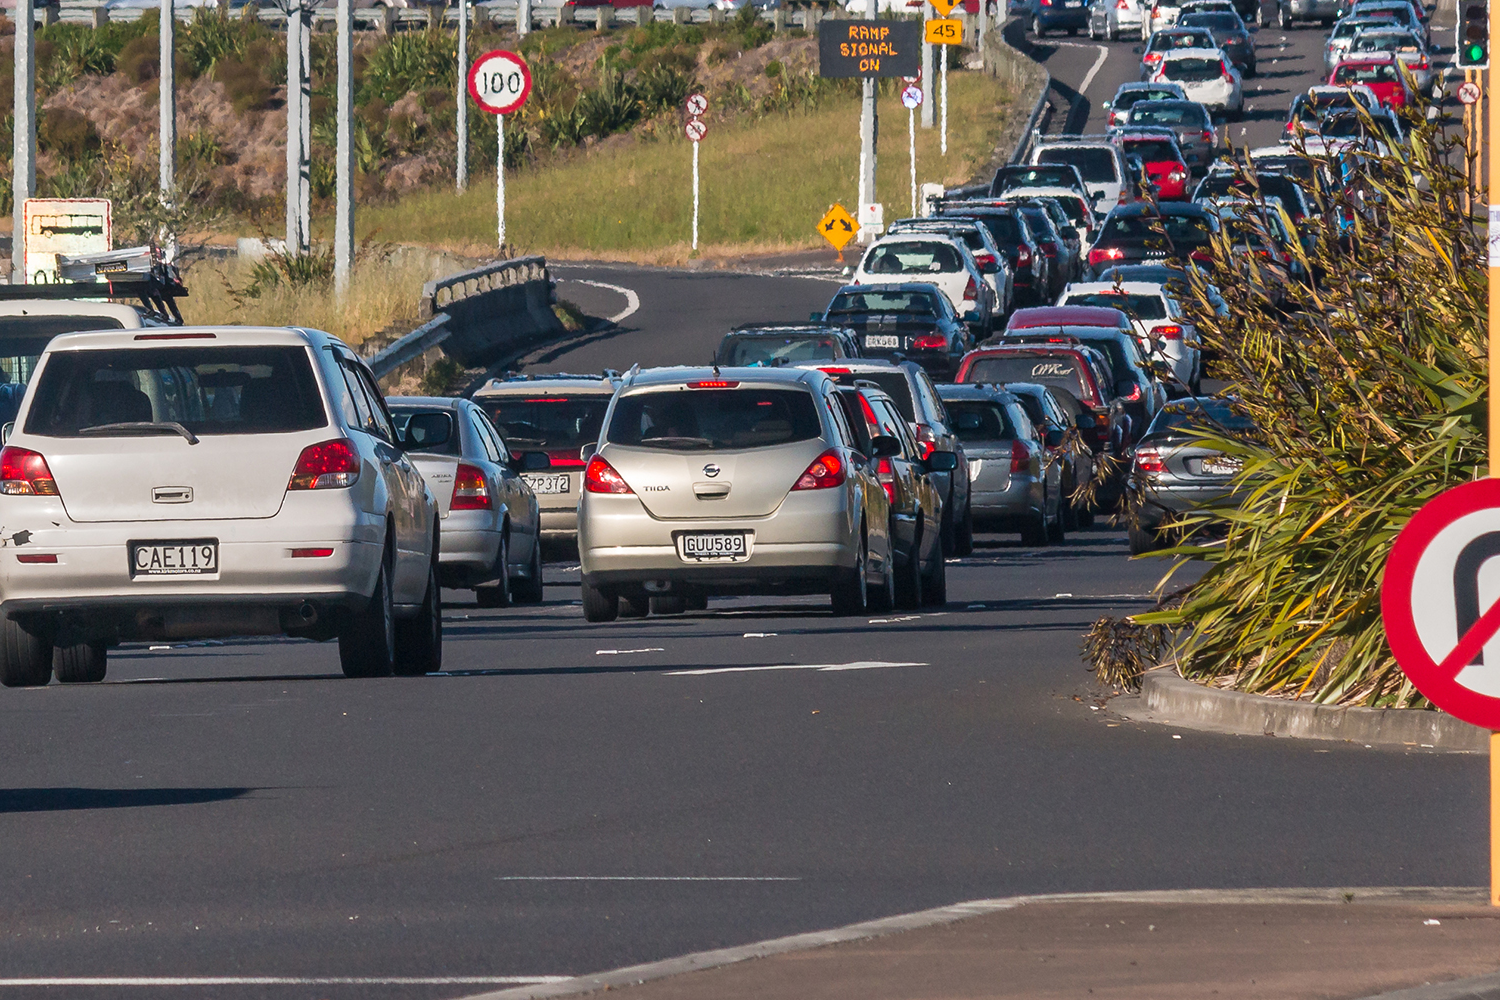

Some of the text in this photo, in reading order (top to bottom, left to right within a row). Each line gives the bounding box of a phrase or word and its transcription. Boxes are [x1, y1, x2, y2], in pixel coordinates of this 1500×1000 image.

[849, 25, 890, 40] RAMP
[933, 25, 955, 37] 45
[840, 42, 898, 57] SIGNAL
[859, 59, 880, 72] ON
[483, 71, 520, 94] 100
[523, 473, 568, 490] ZP372
[687, 537, 742, 552] GUU589
[137, 546, 213, 568] CAE119
